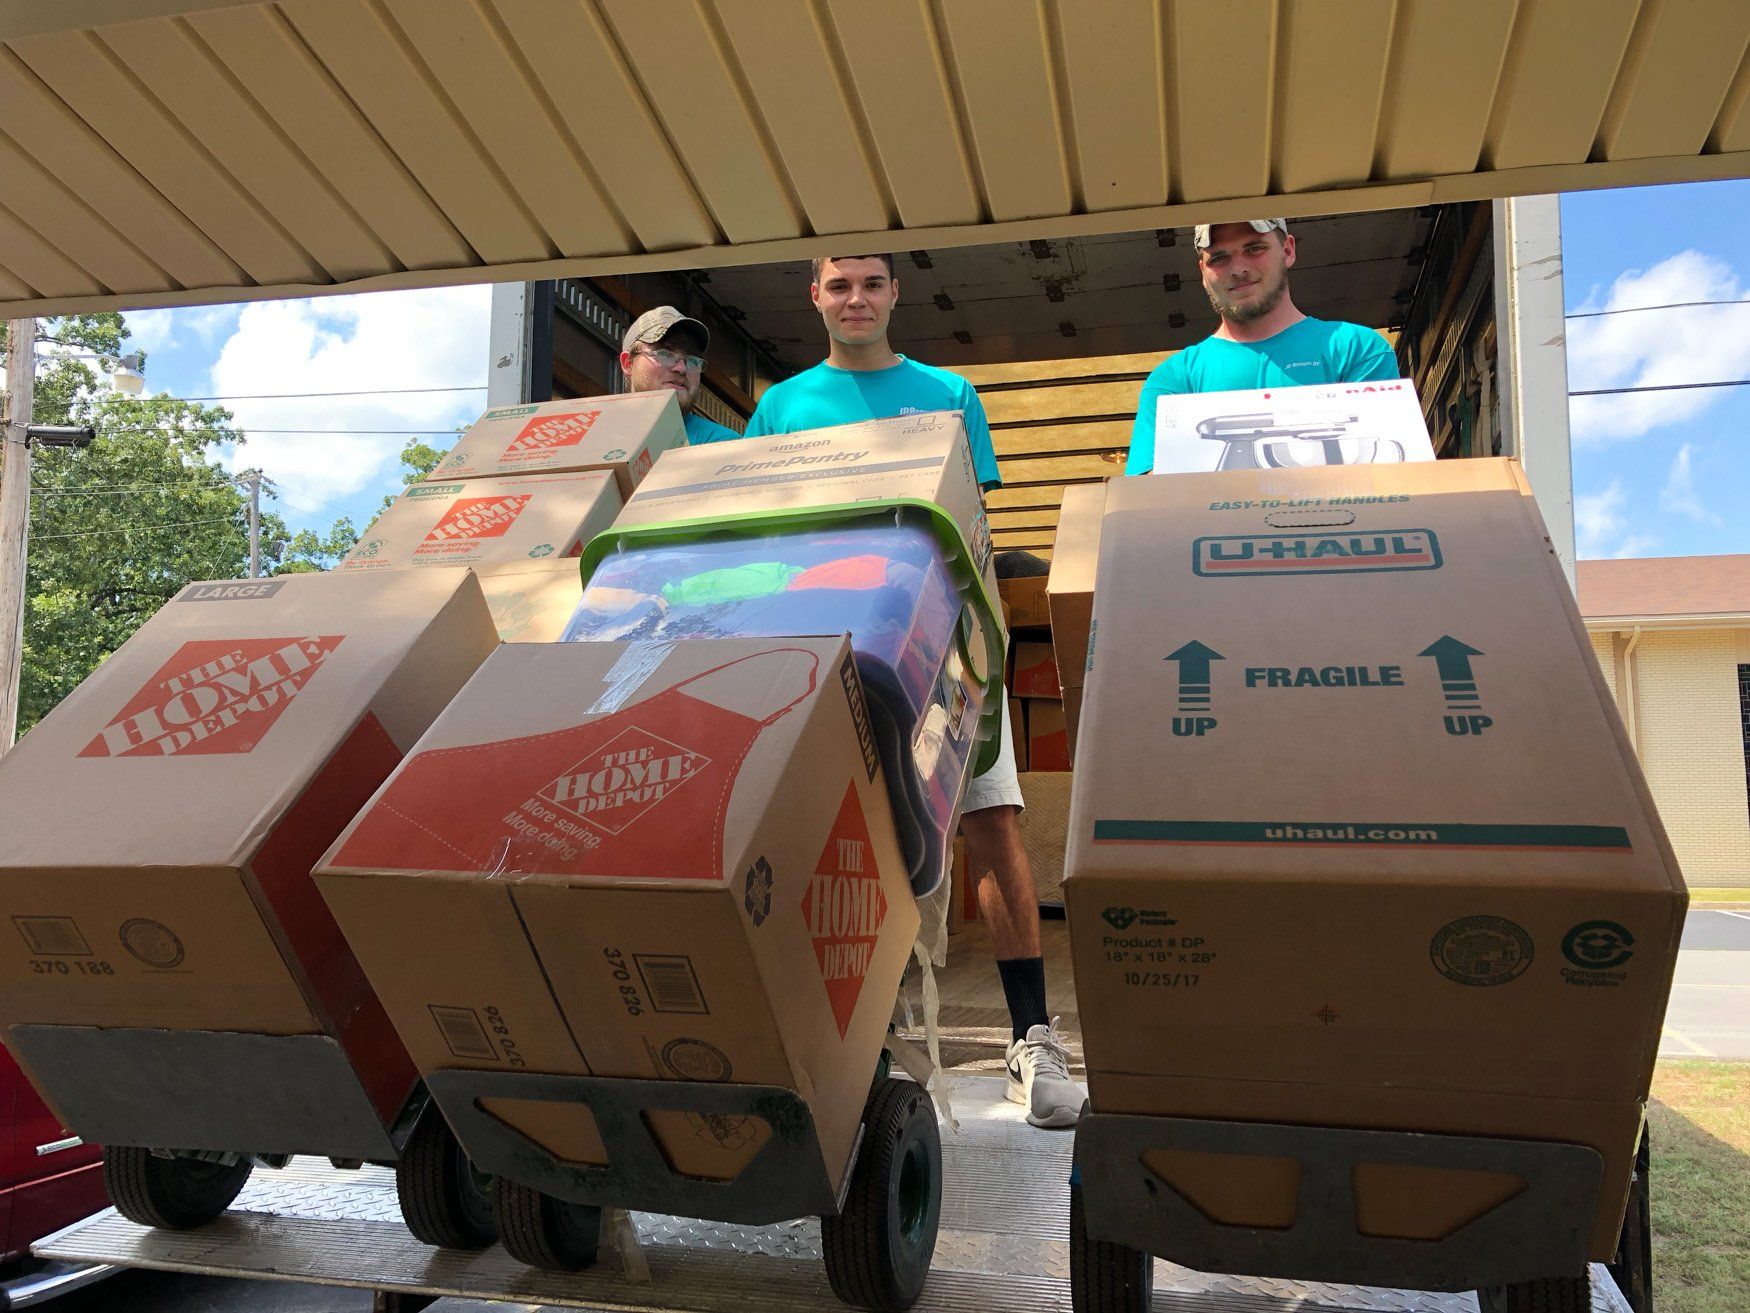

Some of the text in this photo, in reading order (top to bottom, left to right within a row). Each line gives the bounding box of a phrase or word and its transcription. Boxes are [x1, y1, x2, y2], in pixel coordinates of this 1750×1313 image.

[494, 407, 532, 417] SMALL
[512, 411, 601, 450] HOME
[529, 416, 564, 434] THE
[538, 423, 595, 448] DEPOT
[902, 425, 945, 435] HEAVY
[769, 438, 832, 454] amazon
[714, 449, 870, 476] PrimePantry
[743, 475, 795, 486] MEMBER
[799, 466, 868, 480] EXCLUSIVE
[816, 480, 860, 489] PERSONAL
[415, 487, 456, 496] SMALL
[1209, 494, 1411, 511] EASY-TO-LIFT HANDLES
[431, 495, 531, 541] HOME
[451, 502, 489, 520] THE
[460, 509, 519, 539] DEPOT
[1210, 536, 1424, 561] U-HAUL
[192, 584, 272, 599] LARGE
[160, 649, 249, 695] THE
[1245, 665, 1405, 687] FRAGILE
[100, 634, 328, 756] HOME
[155, 676, 300, 756] DEPOT
[843, 666, 876, 773] MEDIUM
[1171, 717, 1218, 737] UP
[1443, 715, 1494, 736] UP
[600, 746, 655, 768] THE
[554, 752, 699, 801] HOME
[576, 781, 670, 815] DEPOT
[520, 797, 602, 850] More saving.
[1264, 826, 1438, 841] uhaul.com
[502, 810, 577, 861] More doing.
[836, 838, 864, 872] THE
[810, 873, 885, 938] HOME
[1102, 936, 1205, 949] Product # DP
[29, 960, 115, 976] 370 188
[822, 941, 871, 981] DEPOT
[1105, 951, 1129, 963] 18"
[1192, 953, 1217, 965] 28"
[602, 947, 646, 1017] 370 826
[1124, 972, 1200, 987] 10/25/17
[482, 1004, 526, 1067] 370 826
